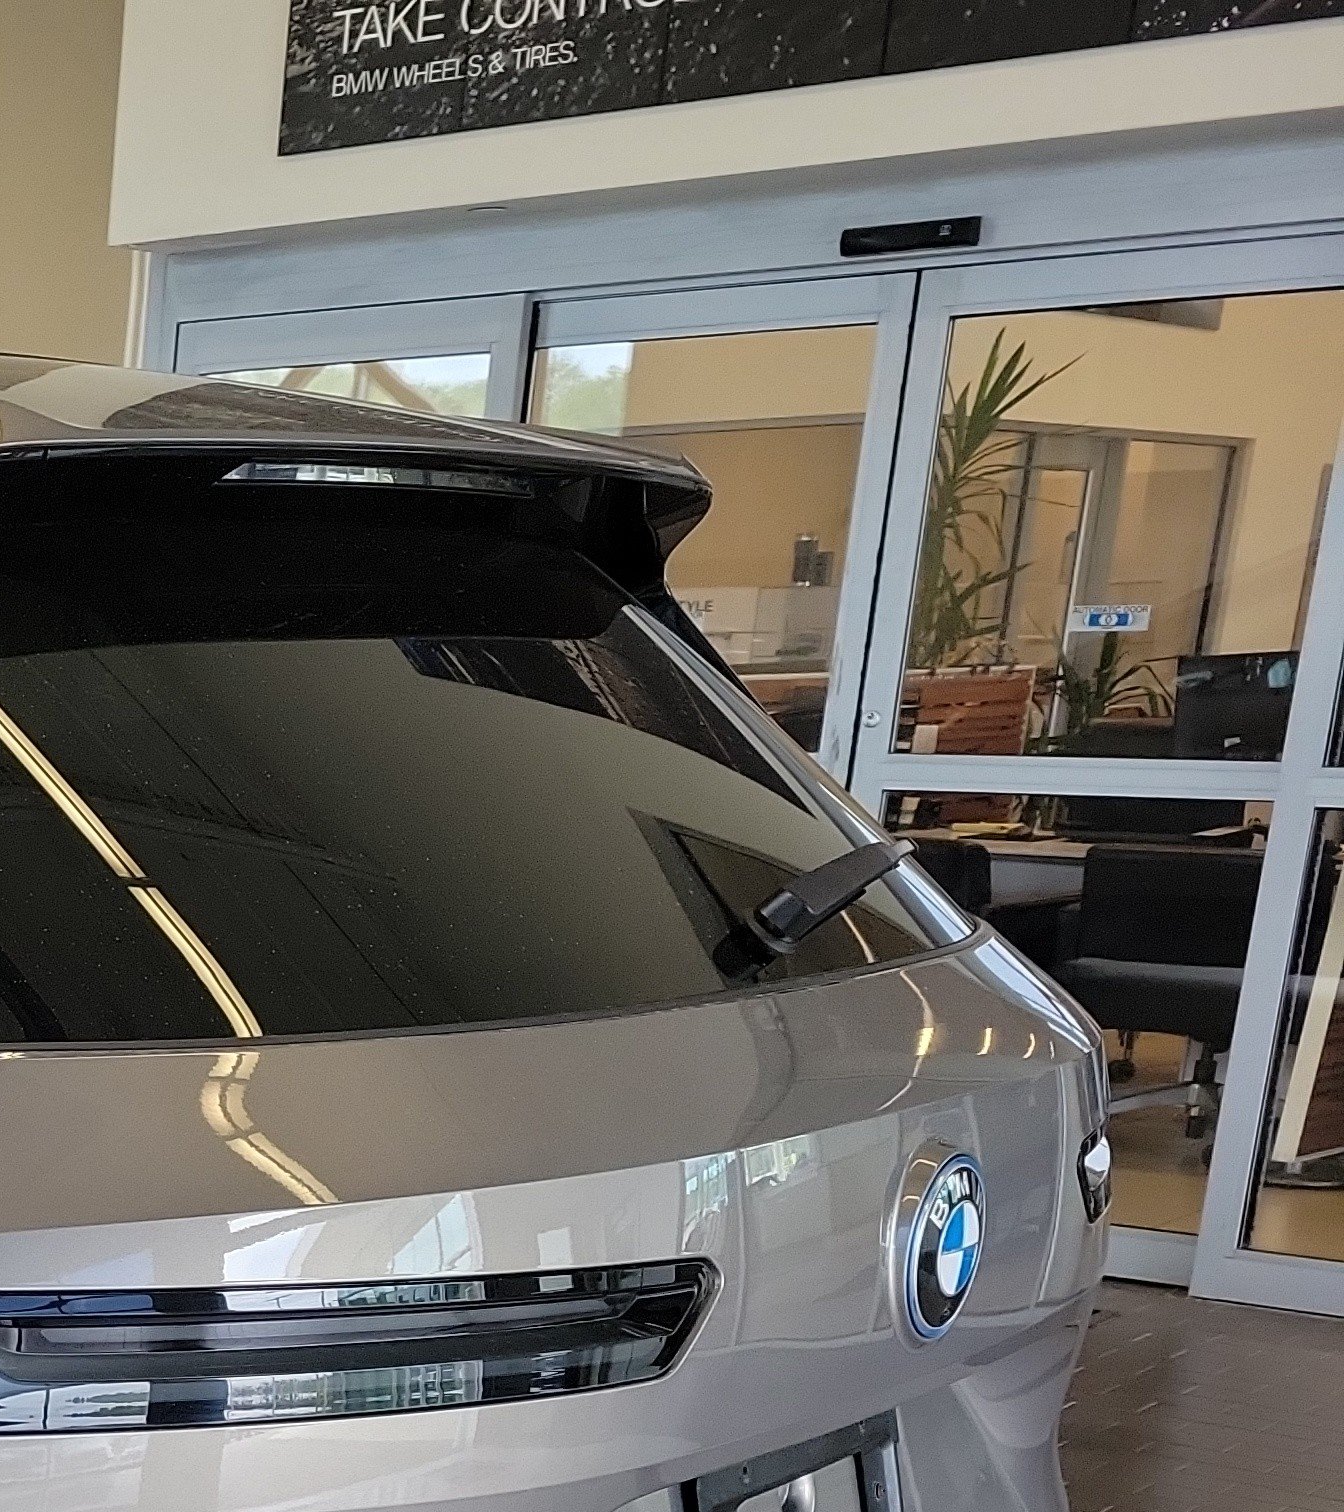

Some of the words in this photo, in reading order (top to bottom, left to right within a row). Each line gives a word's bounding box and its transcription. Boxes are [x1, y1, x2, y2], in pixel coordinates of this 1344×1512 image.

[332, 0, 445, 54] TAKE
[332, 67, 389, 98] BMW
[488, 50, 506, 75] &
[929, 1170, 984, 1230] BMW
